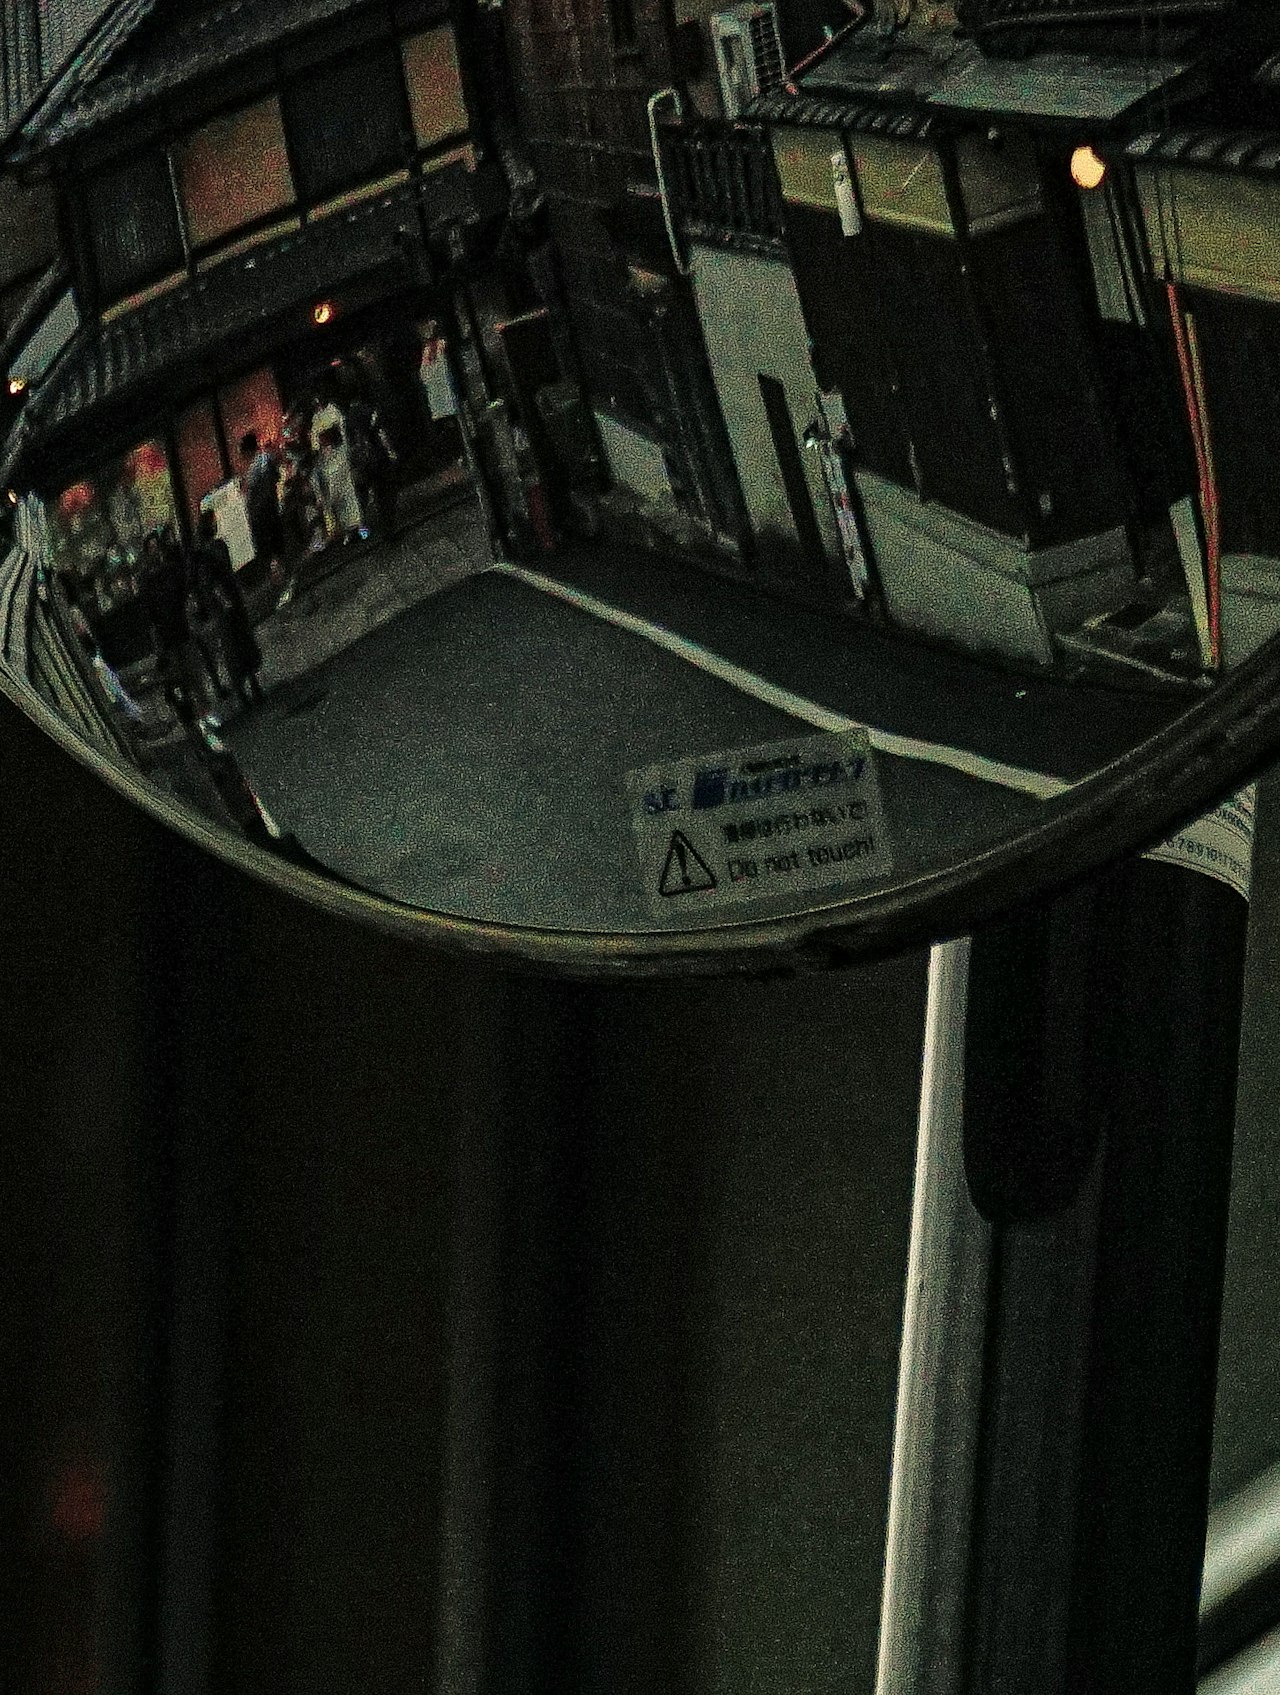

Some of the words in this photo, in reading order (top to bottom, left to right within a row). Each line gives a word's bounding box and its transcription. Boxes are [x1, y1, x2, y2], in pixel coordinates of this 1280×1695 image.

[728, 859, 758, 882] Do
[765, 851, 800, 874] not
[808, 836, 875, 866] touch!
